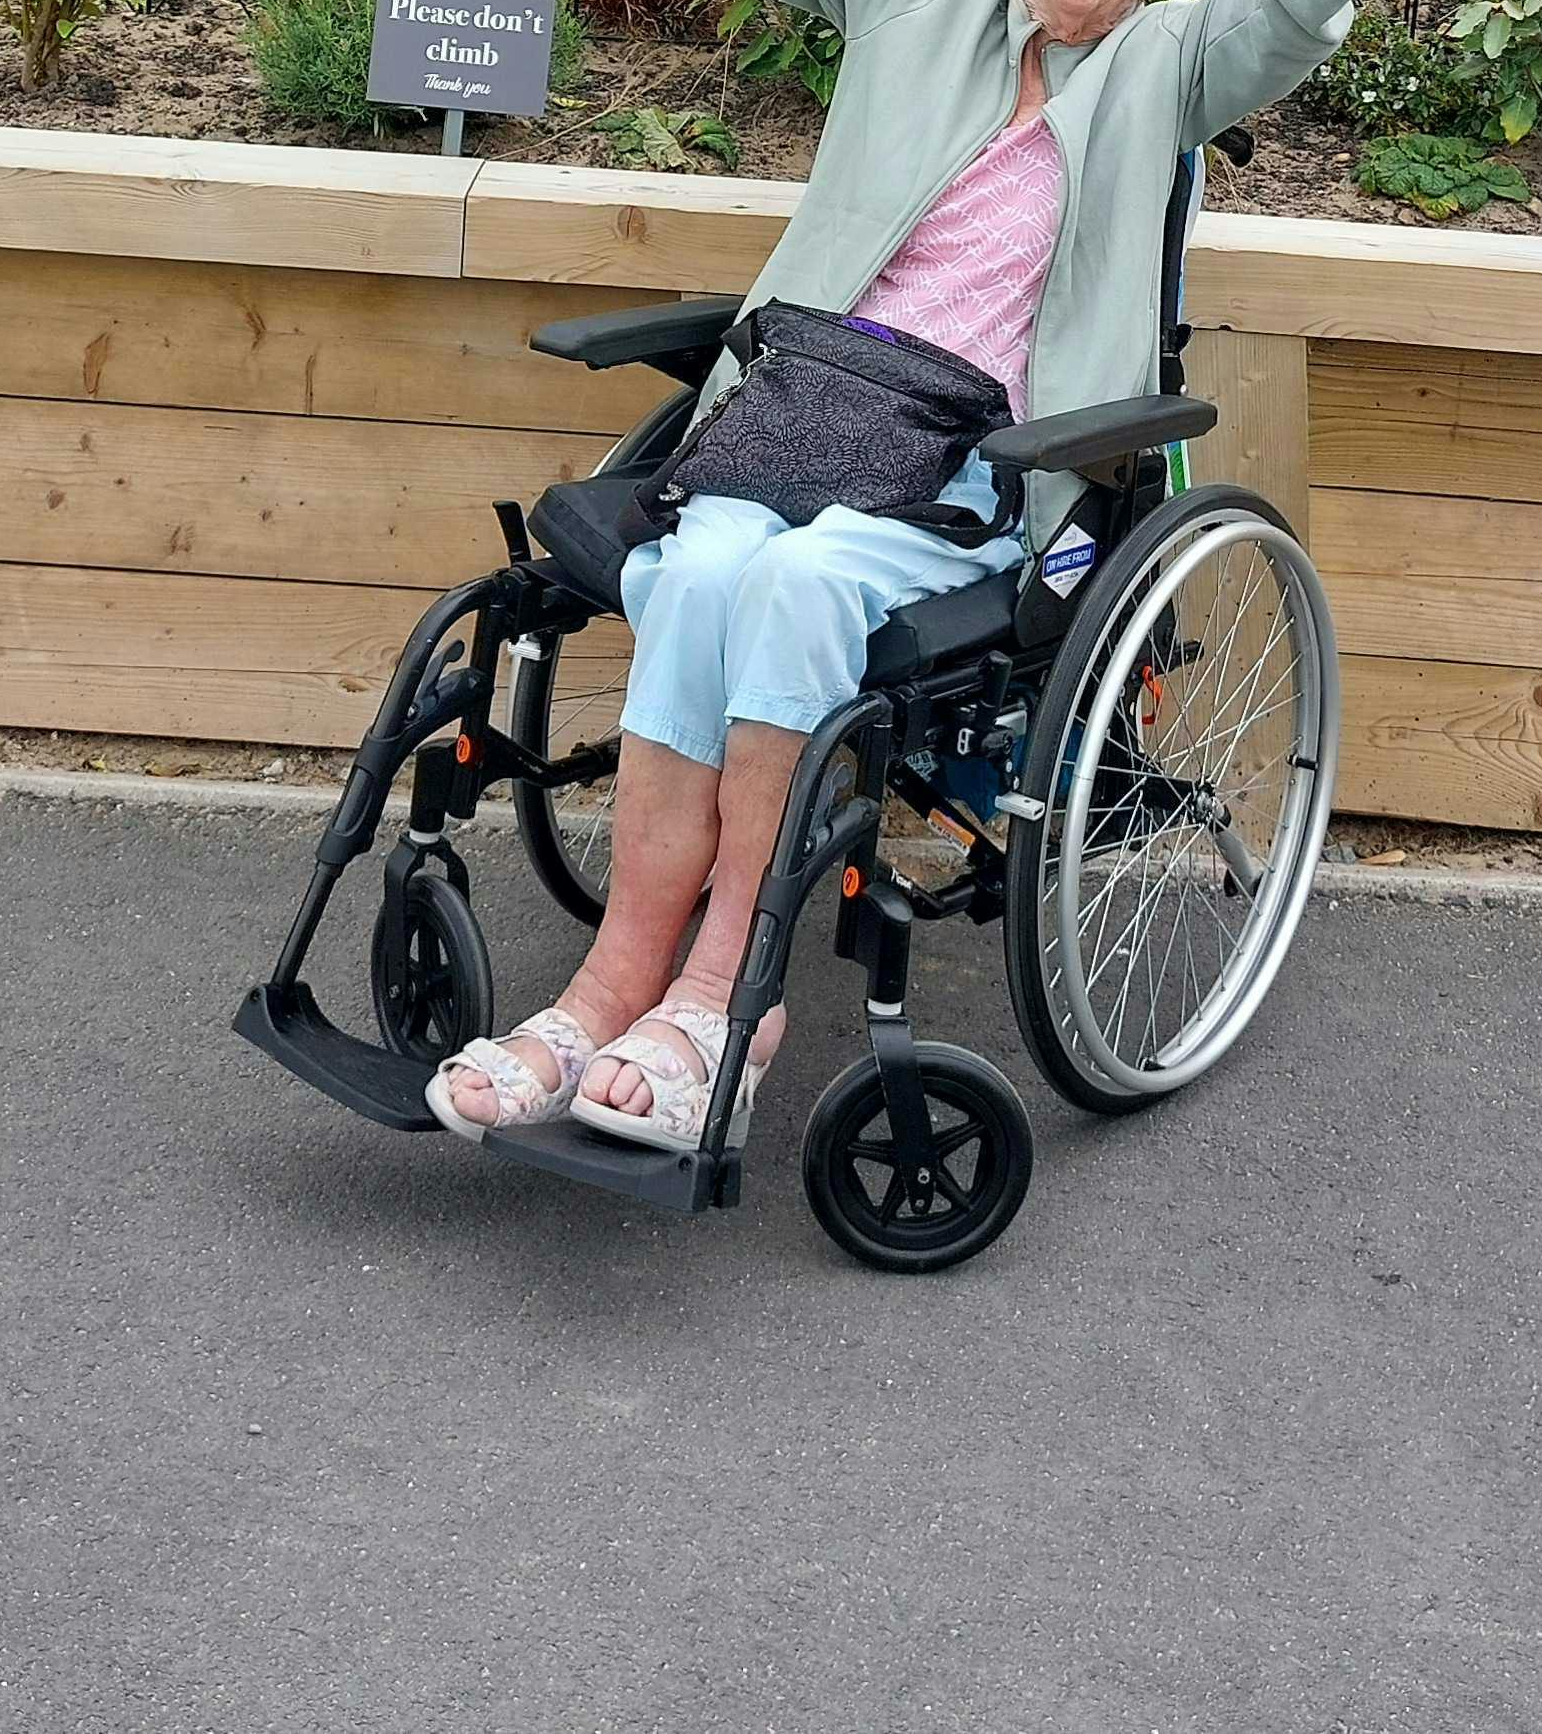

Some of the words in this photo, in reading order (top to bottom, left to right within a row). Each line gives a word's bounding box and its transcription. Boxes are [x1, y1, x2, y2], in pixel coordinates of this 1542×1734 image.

[473, 4, 545, 35] don't
[425, 37, 500, 67] climb
[424, 73, 462, 92] Thank
[463, 80, 492, 98] you
